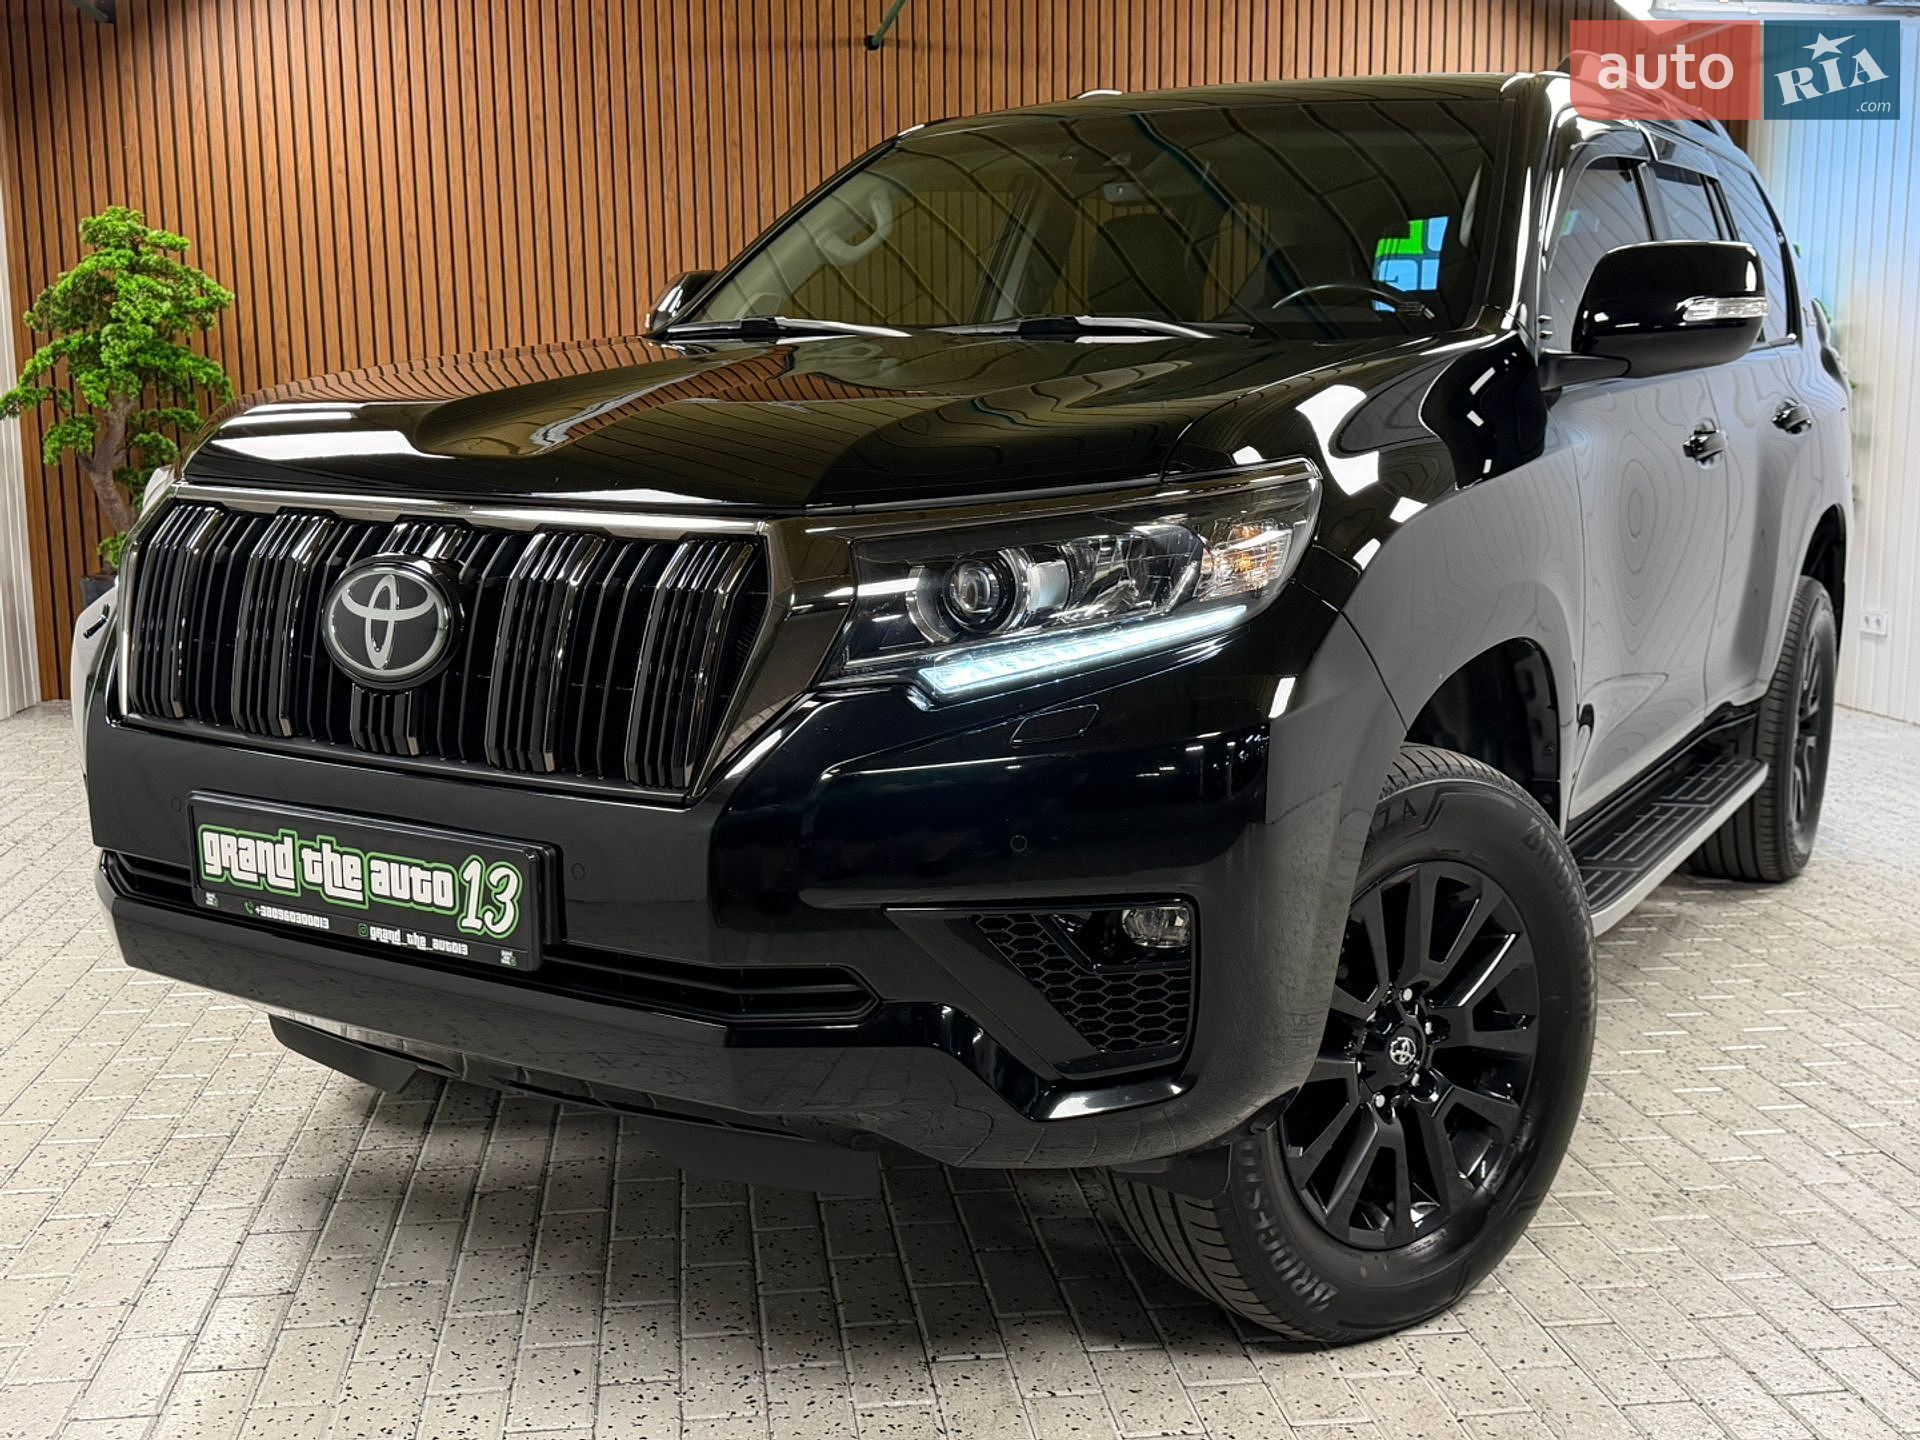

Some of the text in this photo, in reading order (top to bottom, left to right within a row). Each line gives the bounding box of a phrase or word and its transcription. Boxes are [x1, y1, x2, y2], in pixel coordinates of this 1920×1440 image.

[301, 840, 366, 904] the
[369, 858, 456, 910] auto
[461, 859, 520, 934] 13
